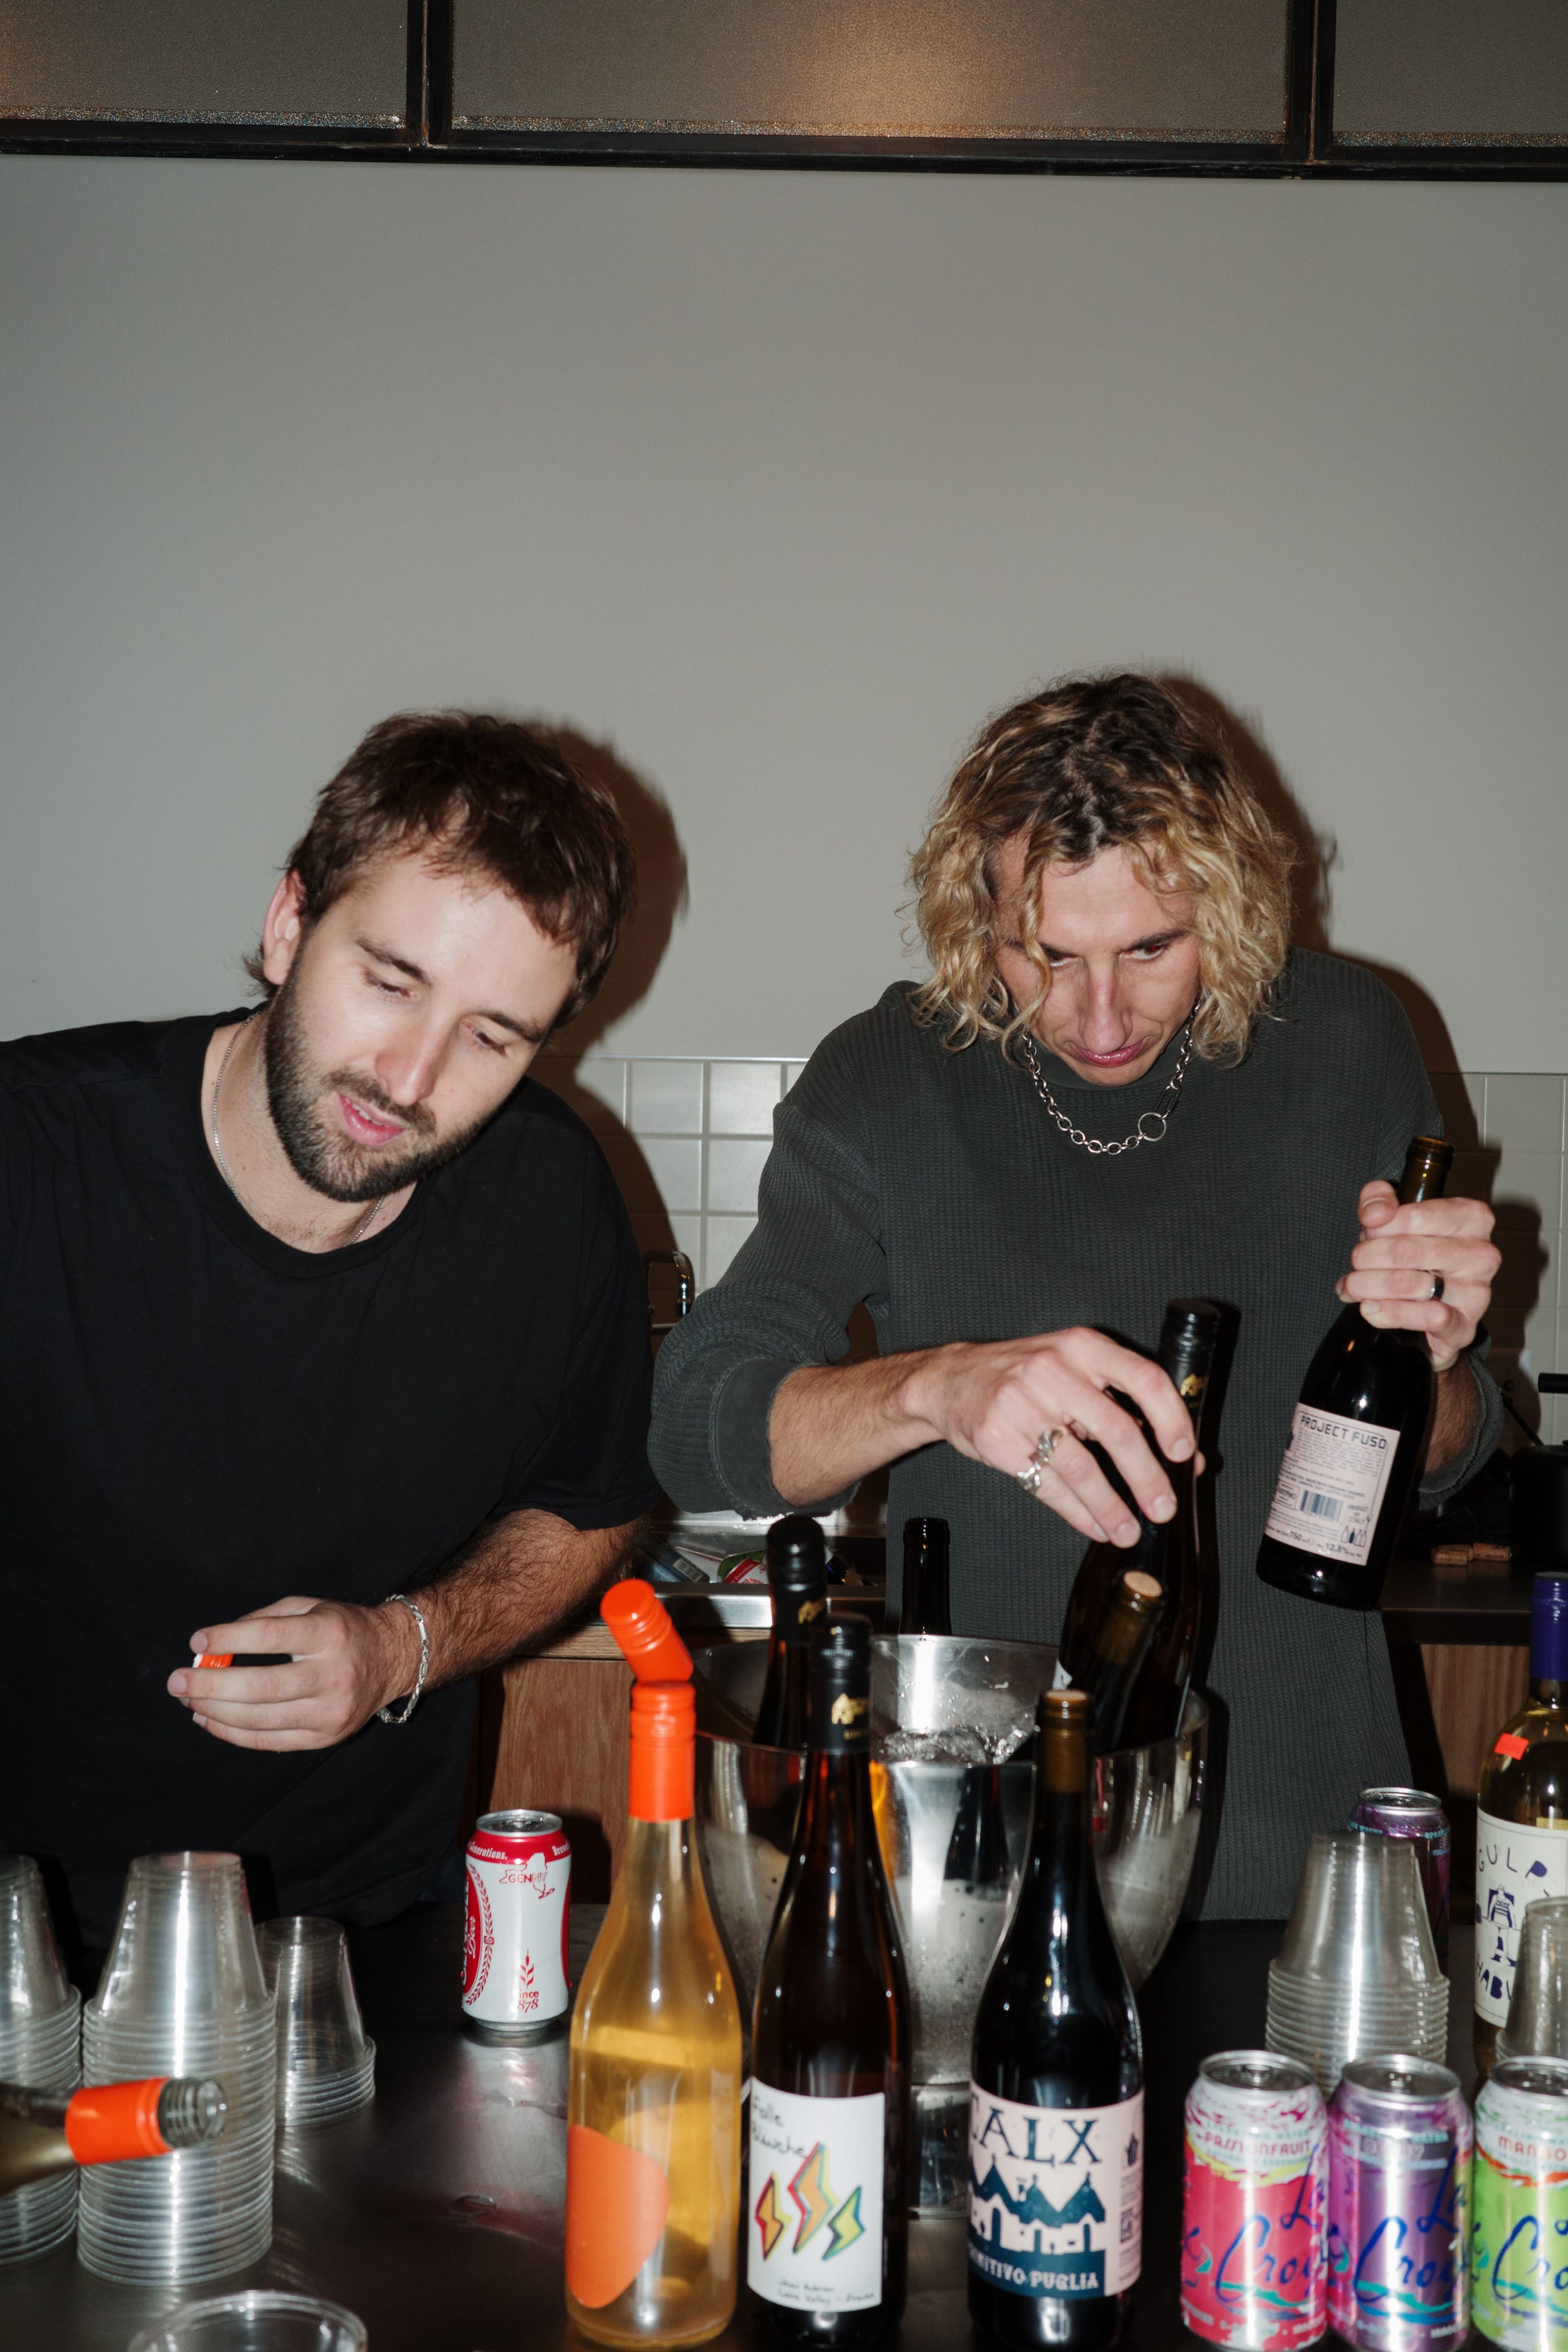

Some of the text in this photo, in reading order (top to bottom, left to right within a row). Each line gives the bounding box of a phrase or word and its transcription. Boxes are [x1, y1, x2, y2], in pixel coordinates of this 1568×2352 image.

[1300, 1415, 1387, 1450] PROJECT FUSO
[1478, 1844, 1547, 1878] GULP
[509, 1872, 548, 1884] GENNY
[466, 1915, 476, 1959] Beer
[519, 1989, 539, 1998] ince
[518, 1998, 539, 2013] 878
[1029, 2270, 1099, 2291] PUGLIA
